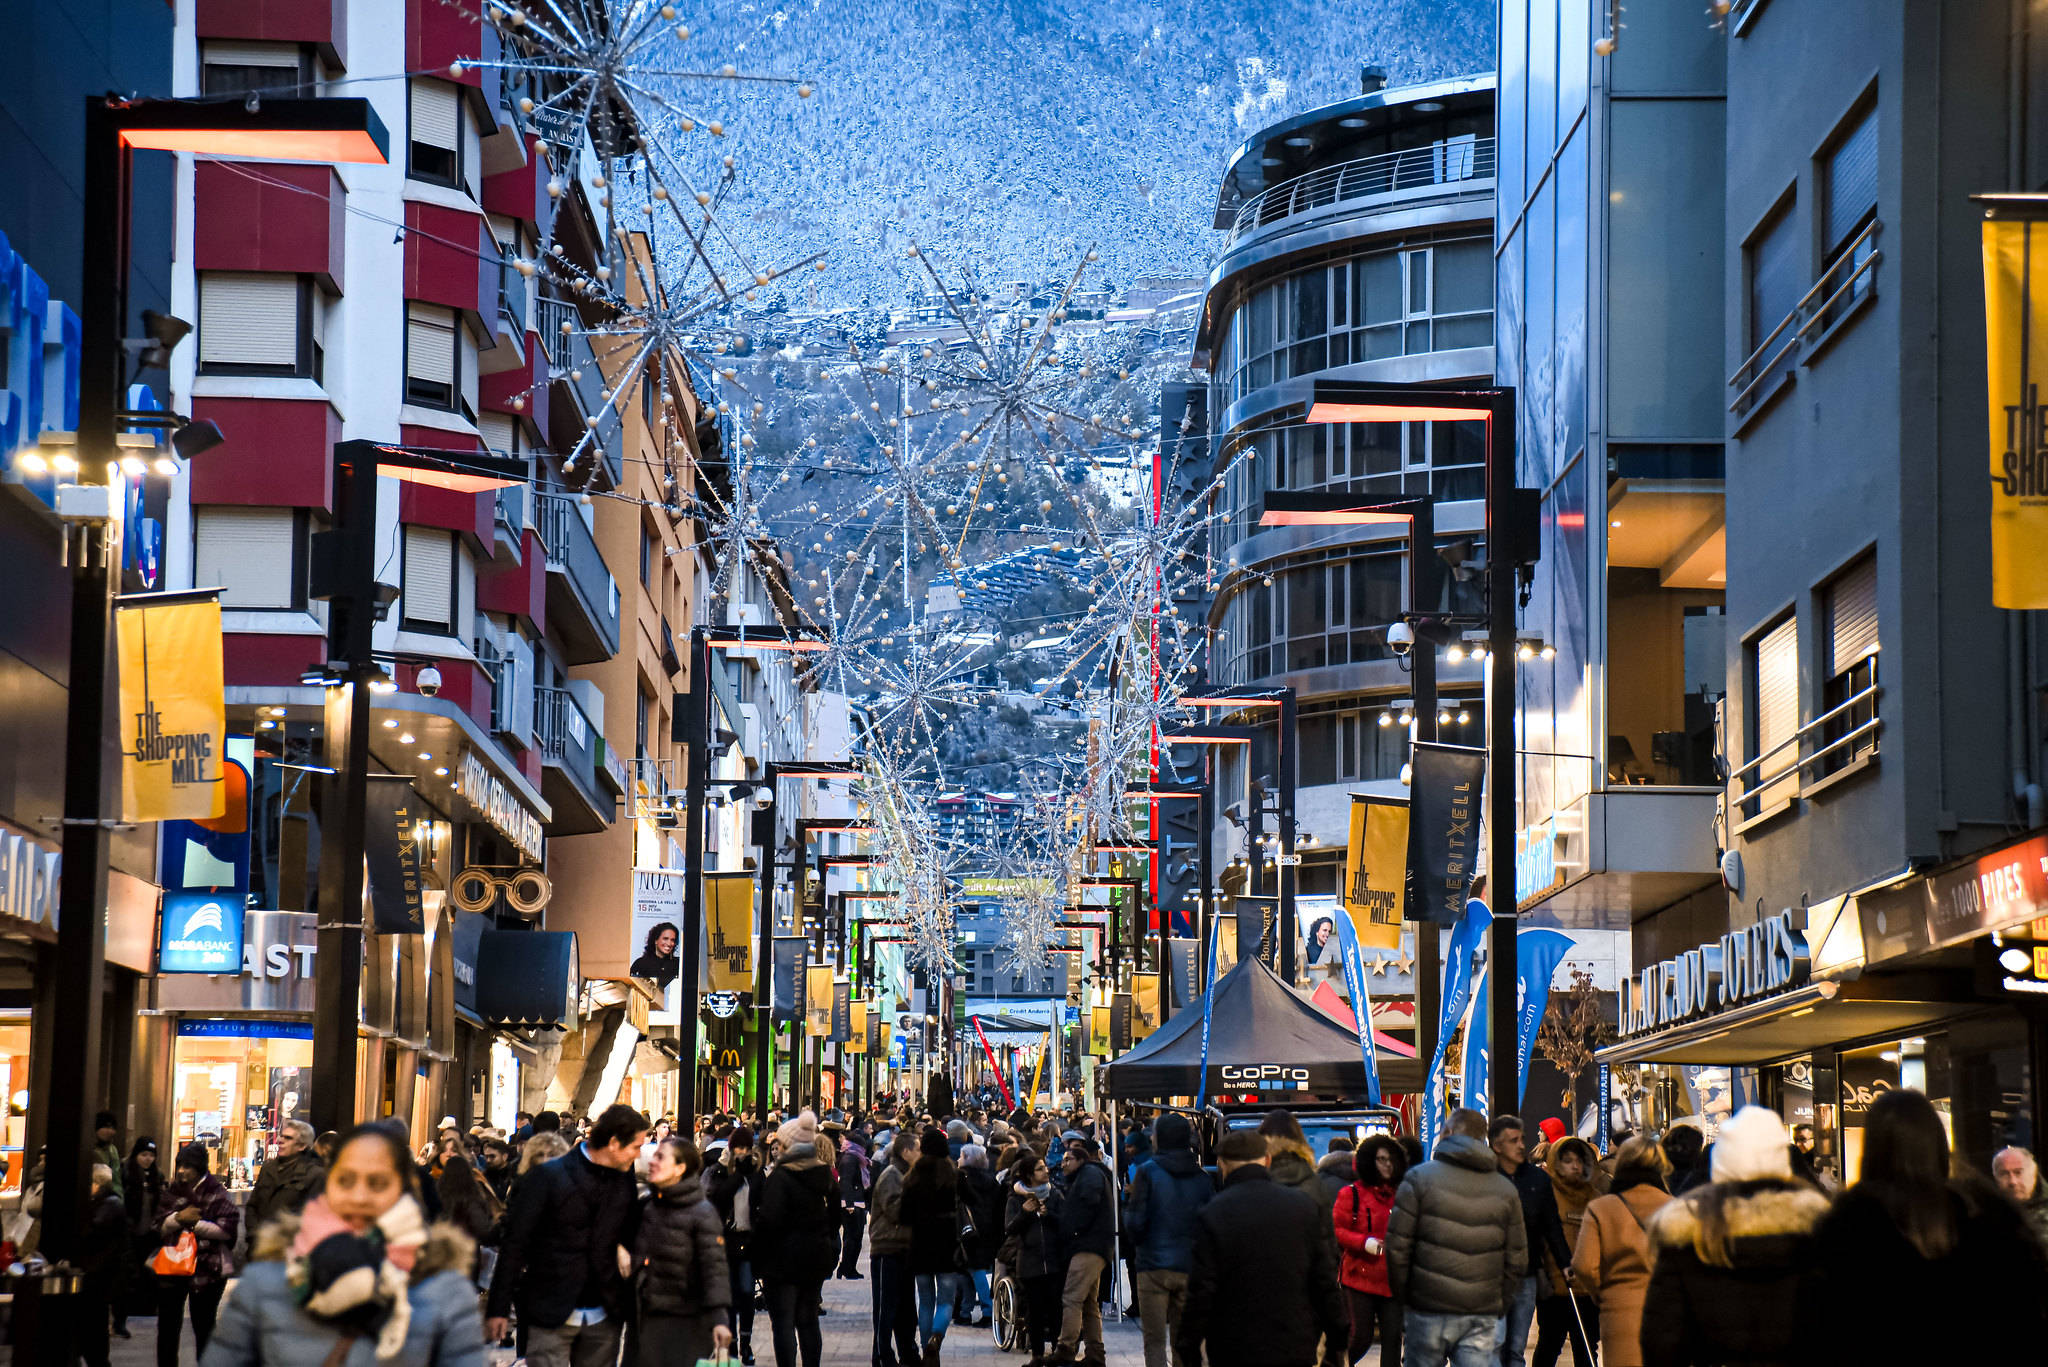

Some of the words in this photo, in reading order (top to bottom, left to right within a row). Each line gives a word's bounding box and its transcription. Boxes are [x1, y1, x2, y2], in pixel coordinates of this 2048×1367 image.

[134, 703, 163, 737] THE
[135, 733, 211, 763] SHOPPING
[172, 757, 207, 785] MILE
[1444, 781, 1471, 913] MERITXELL
[395, 807, 421, 924] MERITXELL
[1354, 864, 1369, 889] THE
[1351, 888, 1395, 909] SHOPPING
[1952, 880, 1979, 919] 1000
[1981, 862, 2022, 909] PIPES
[1370, 907, 1391, 925] MILE
[1260, 905, 1271, 961] Boulevard
[1718, 907, 1802, 1006] JOIERS
[1222, 1065, 1309, 1080] GoPro
[1794, 1106, 1814, 1116] JUN
